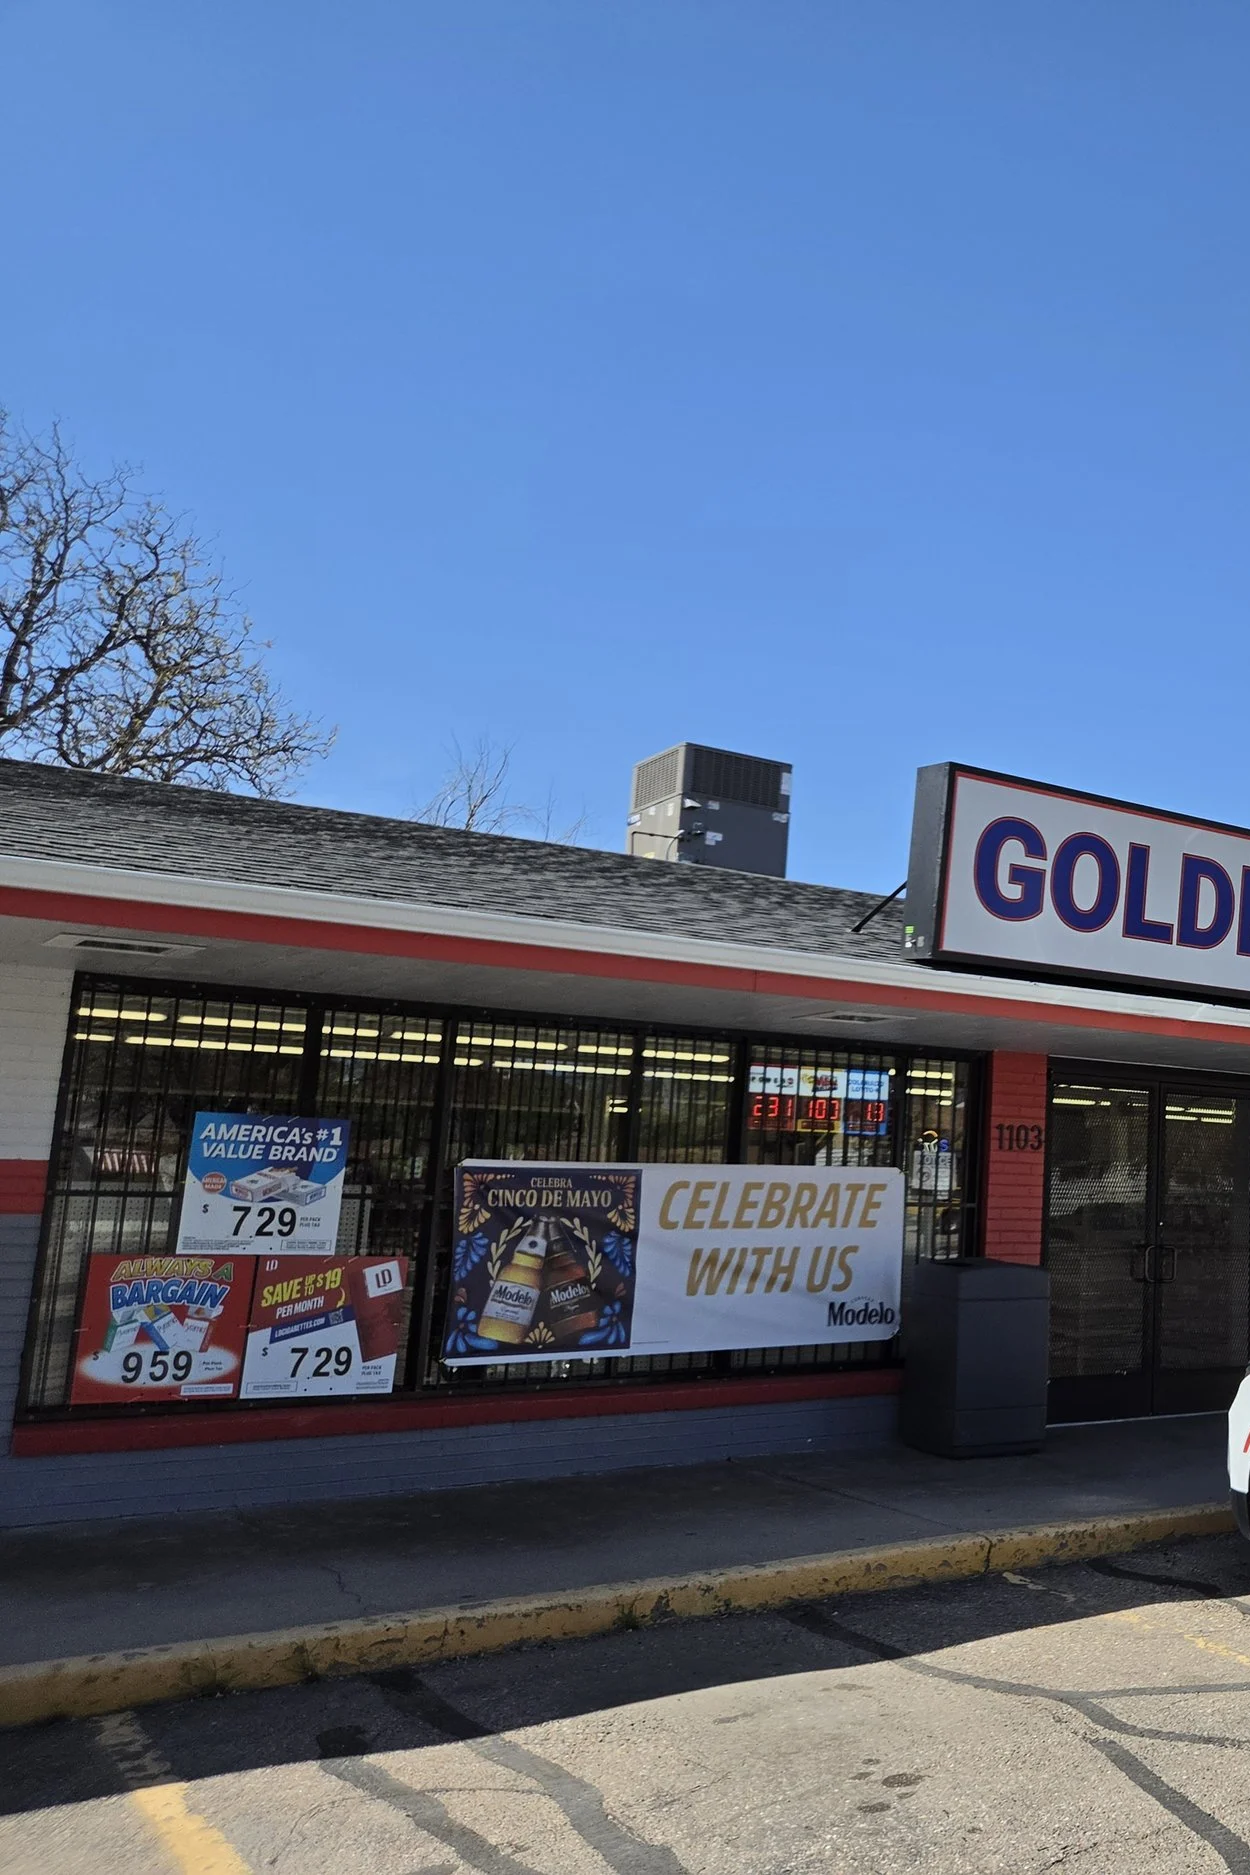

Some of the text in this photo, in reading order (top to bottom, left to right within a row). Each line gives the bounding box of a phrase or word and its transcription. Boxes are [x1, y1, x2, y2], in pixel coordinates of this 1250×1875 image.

[200, 1123, 342, 1146] AMERICA's #1
[996, 1123, 1042, 1151] 1103
[202, 1142, 338, 1162] VALUE BRAND
[530, 1177, 573, 1188] CELEBRA
[202, 1204, 209, 1214] $
[487, 1189, 612, 1208] CINCO DE MAYO
[659, 1180, 888, 1230] CELEBRATE
[110, 1257, 234, 1282] ALWAYS A
[266, 1259, 278, 1272] LD
[686, 1245, 859, 1296] WITH US
[304, 1274, 316, 1286] UP
[375, 1268, 393, 1289] LD
[111, 1278, 231, 1312] BARGAIN
[261, 1278, 303, 1307] SAVE
[304, 1285, 315, 1297] TO
[498, 1284, 533, 1306] Modelo
[551, 1283, 589, 1305] Modelo
[275, 1296, 325, 1320] PER MONTH
[828, 1302, 895, 1327] Modelo
[93, 1351, 100, 1361] $
[262, 1347, 269, 1357] $
